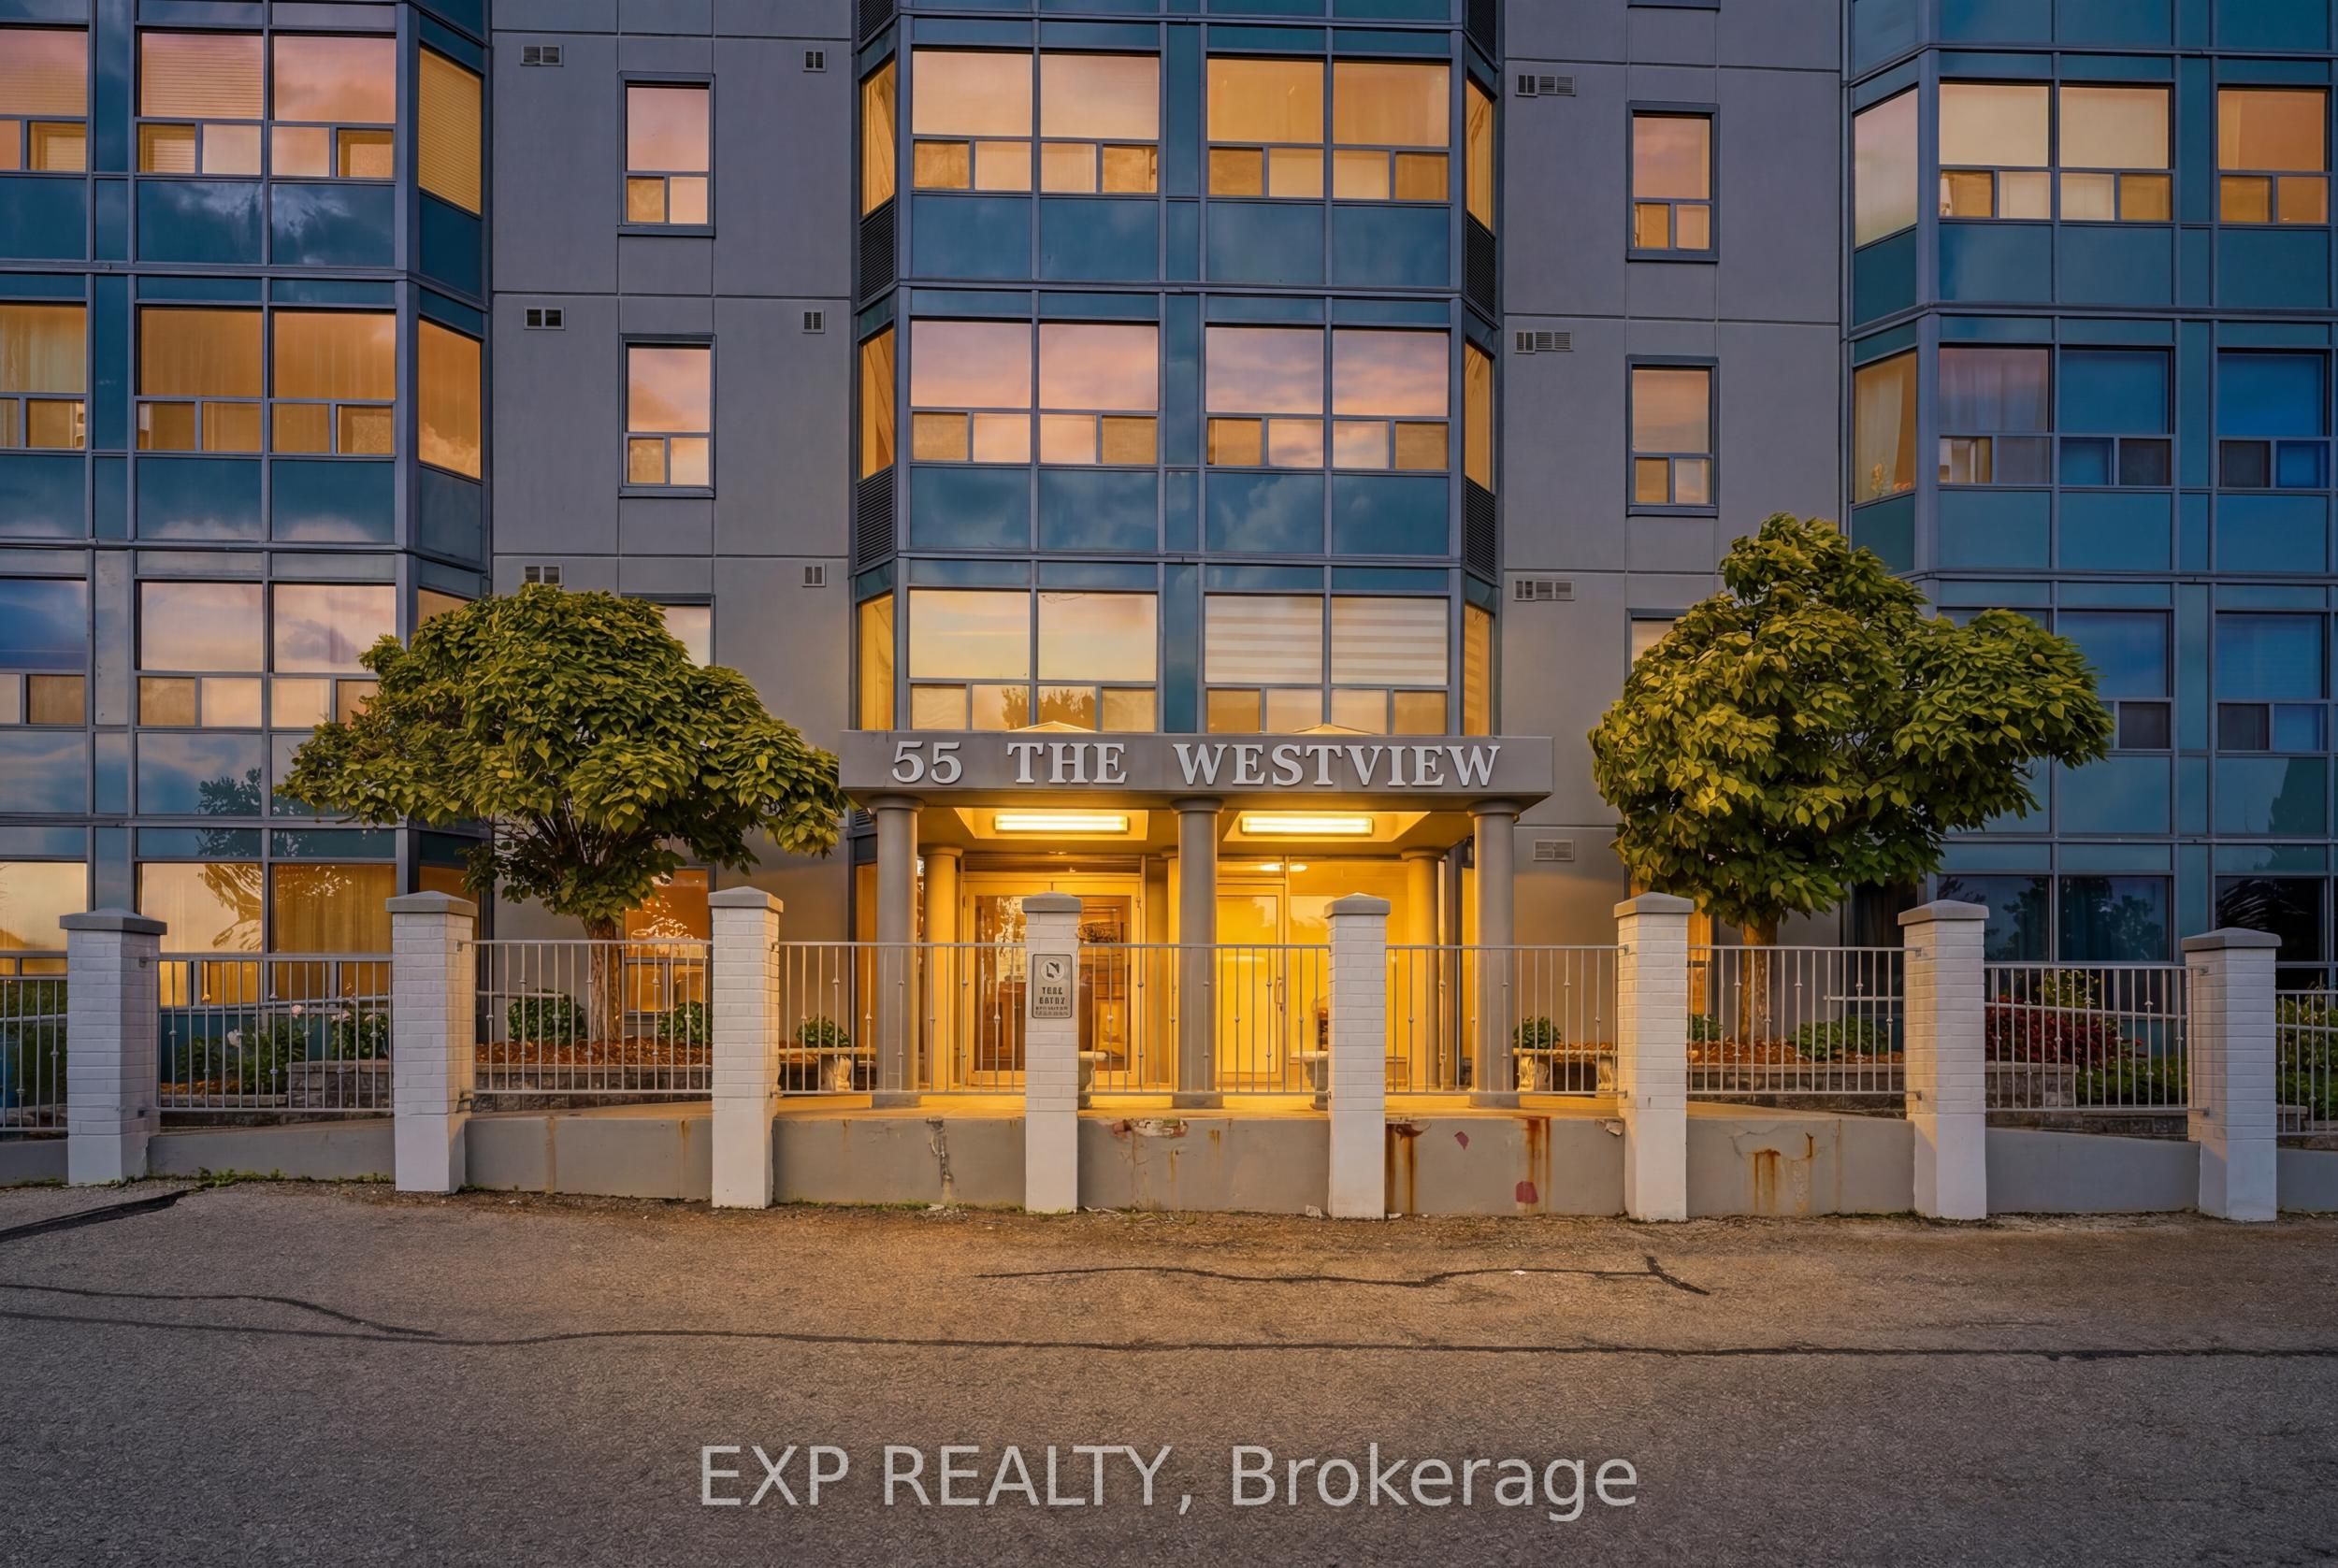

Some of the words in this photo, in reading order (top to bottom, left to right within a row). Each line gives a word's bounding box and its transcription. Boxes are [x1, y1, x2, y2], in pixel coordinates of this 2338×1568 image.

[891, 741, 963, 784] 55
[1006, 742, 1128, 784] THE
[1172, 743, 1501, 787] WESTVIEW
